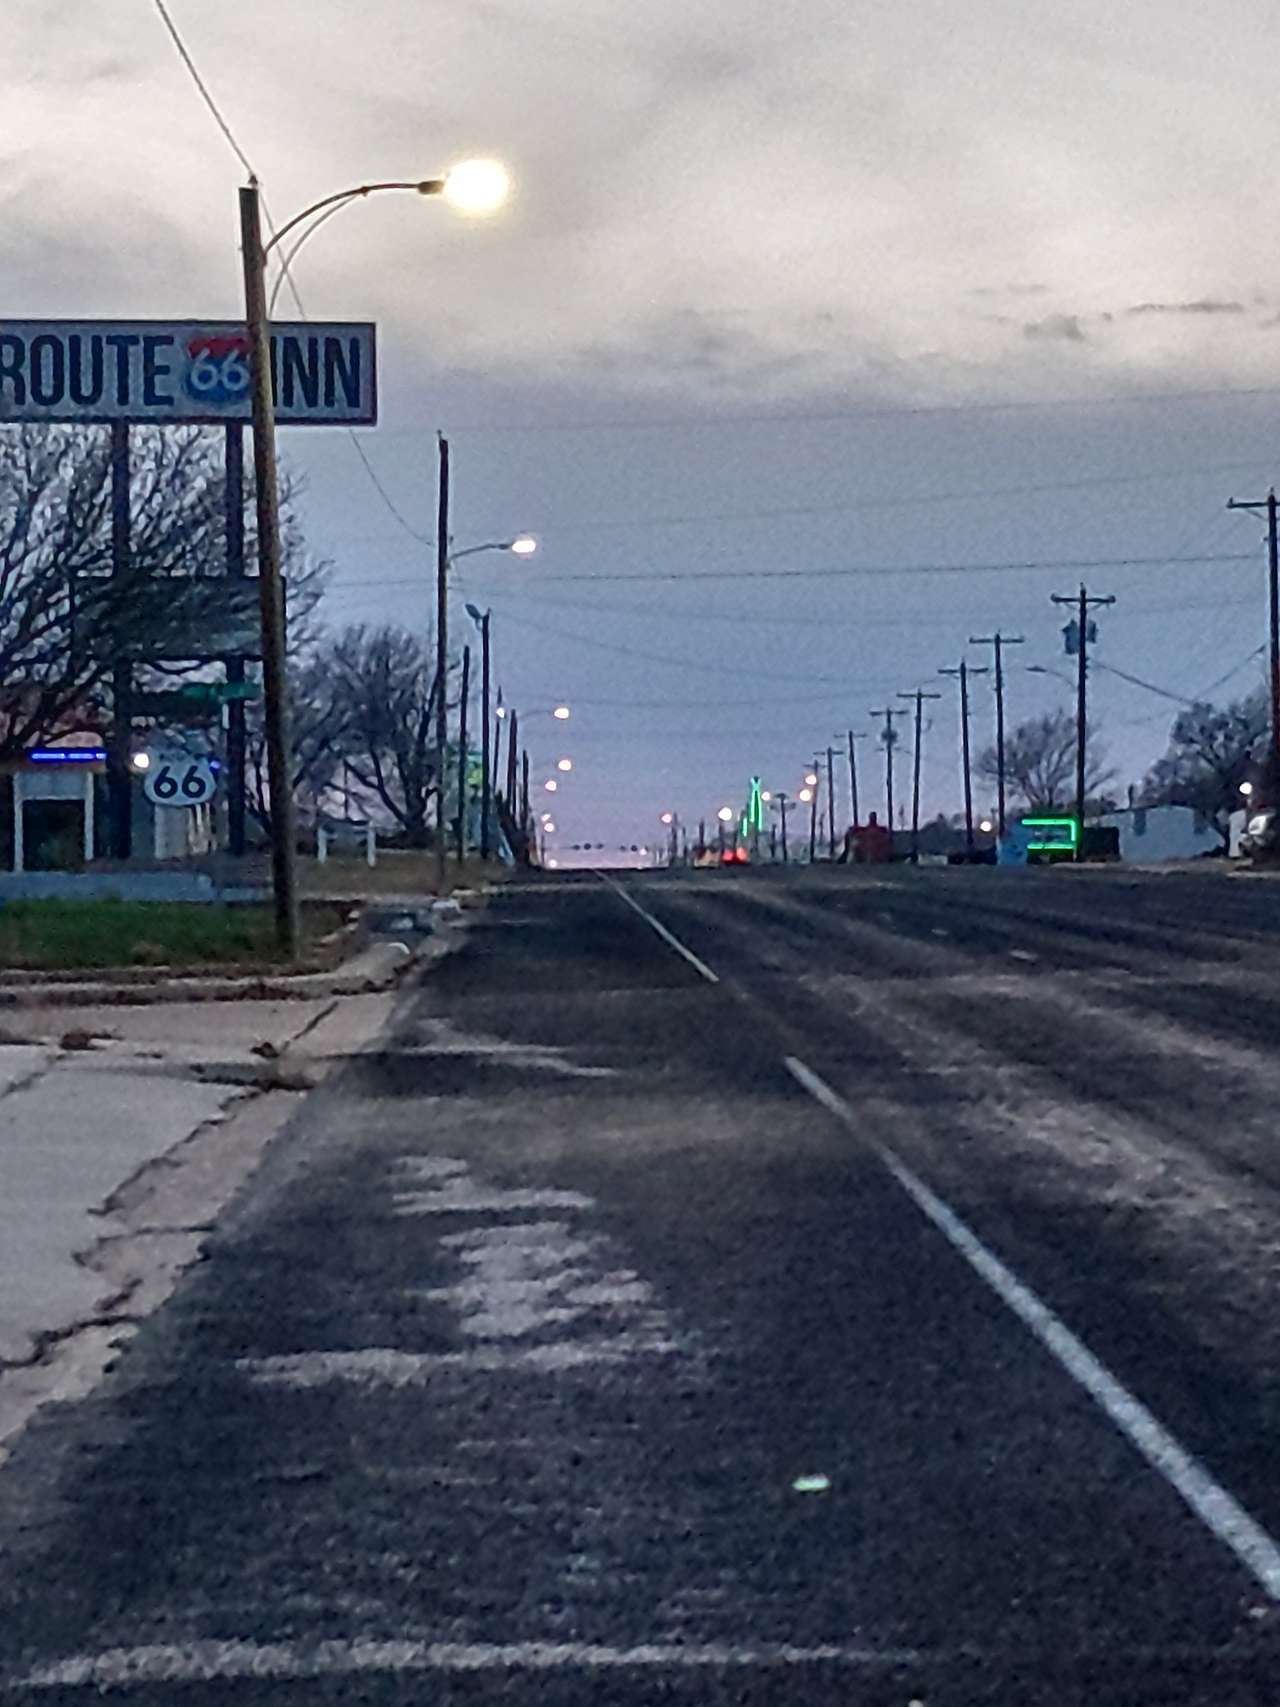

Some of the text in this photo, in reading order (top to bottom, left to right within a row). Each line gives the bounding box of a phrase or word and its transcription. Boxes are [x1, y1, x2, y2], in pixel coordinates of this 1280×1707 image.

[0, 334, 174, 406] ROUTE
[190, 347, 251, 391] 66
[153, 765, 206, 799] 66
